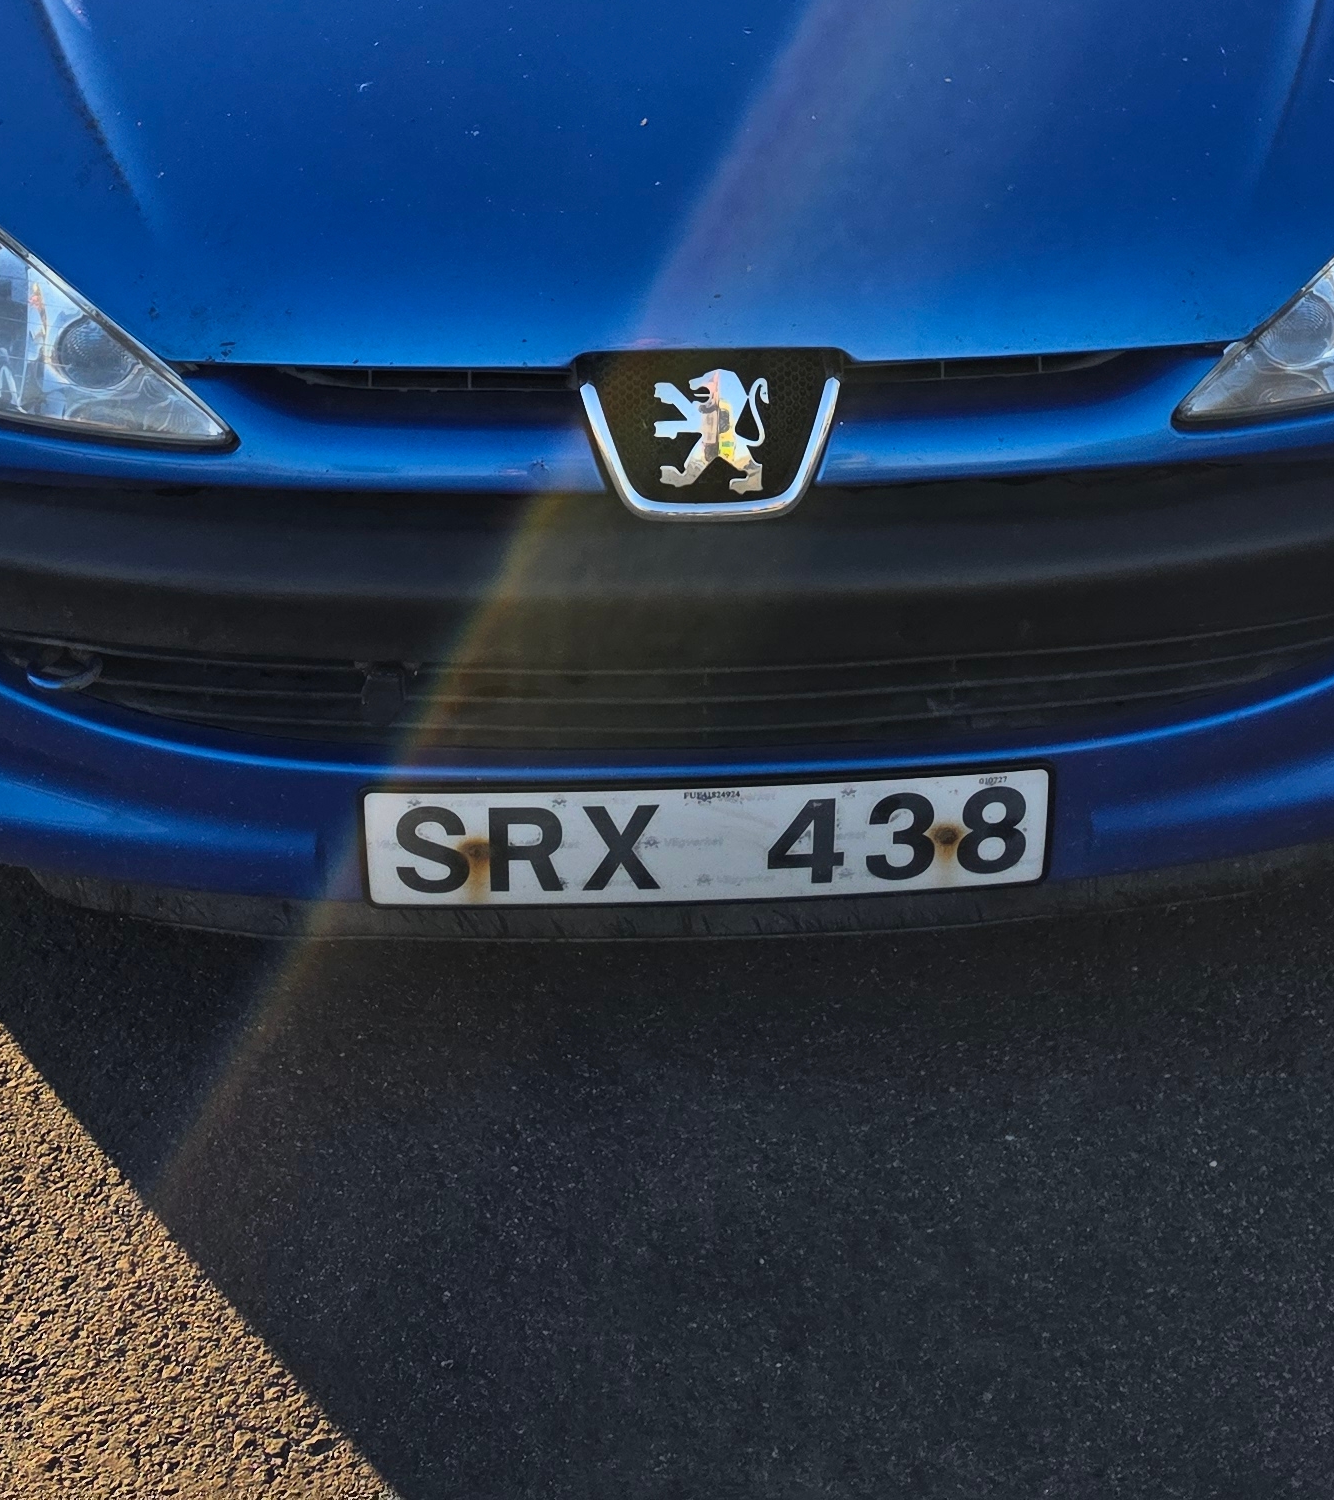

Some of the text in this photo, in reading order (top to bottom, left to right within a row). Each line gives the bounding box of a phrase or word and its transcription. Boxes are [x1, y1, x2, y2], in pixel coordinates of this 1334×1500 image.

[978, 775, 1008, 786] 010727
[395, 786, 1028, 894] SRX 438
